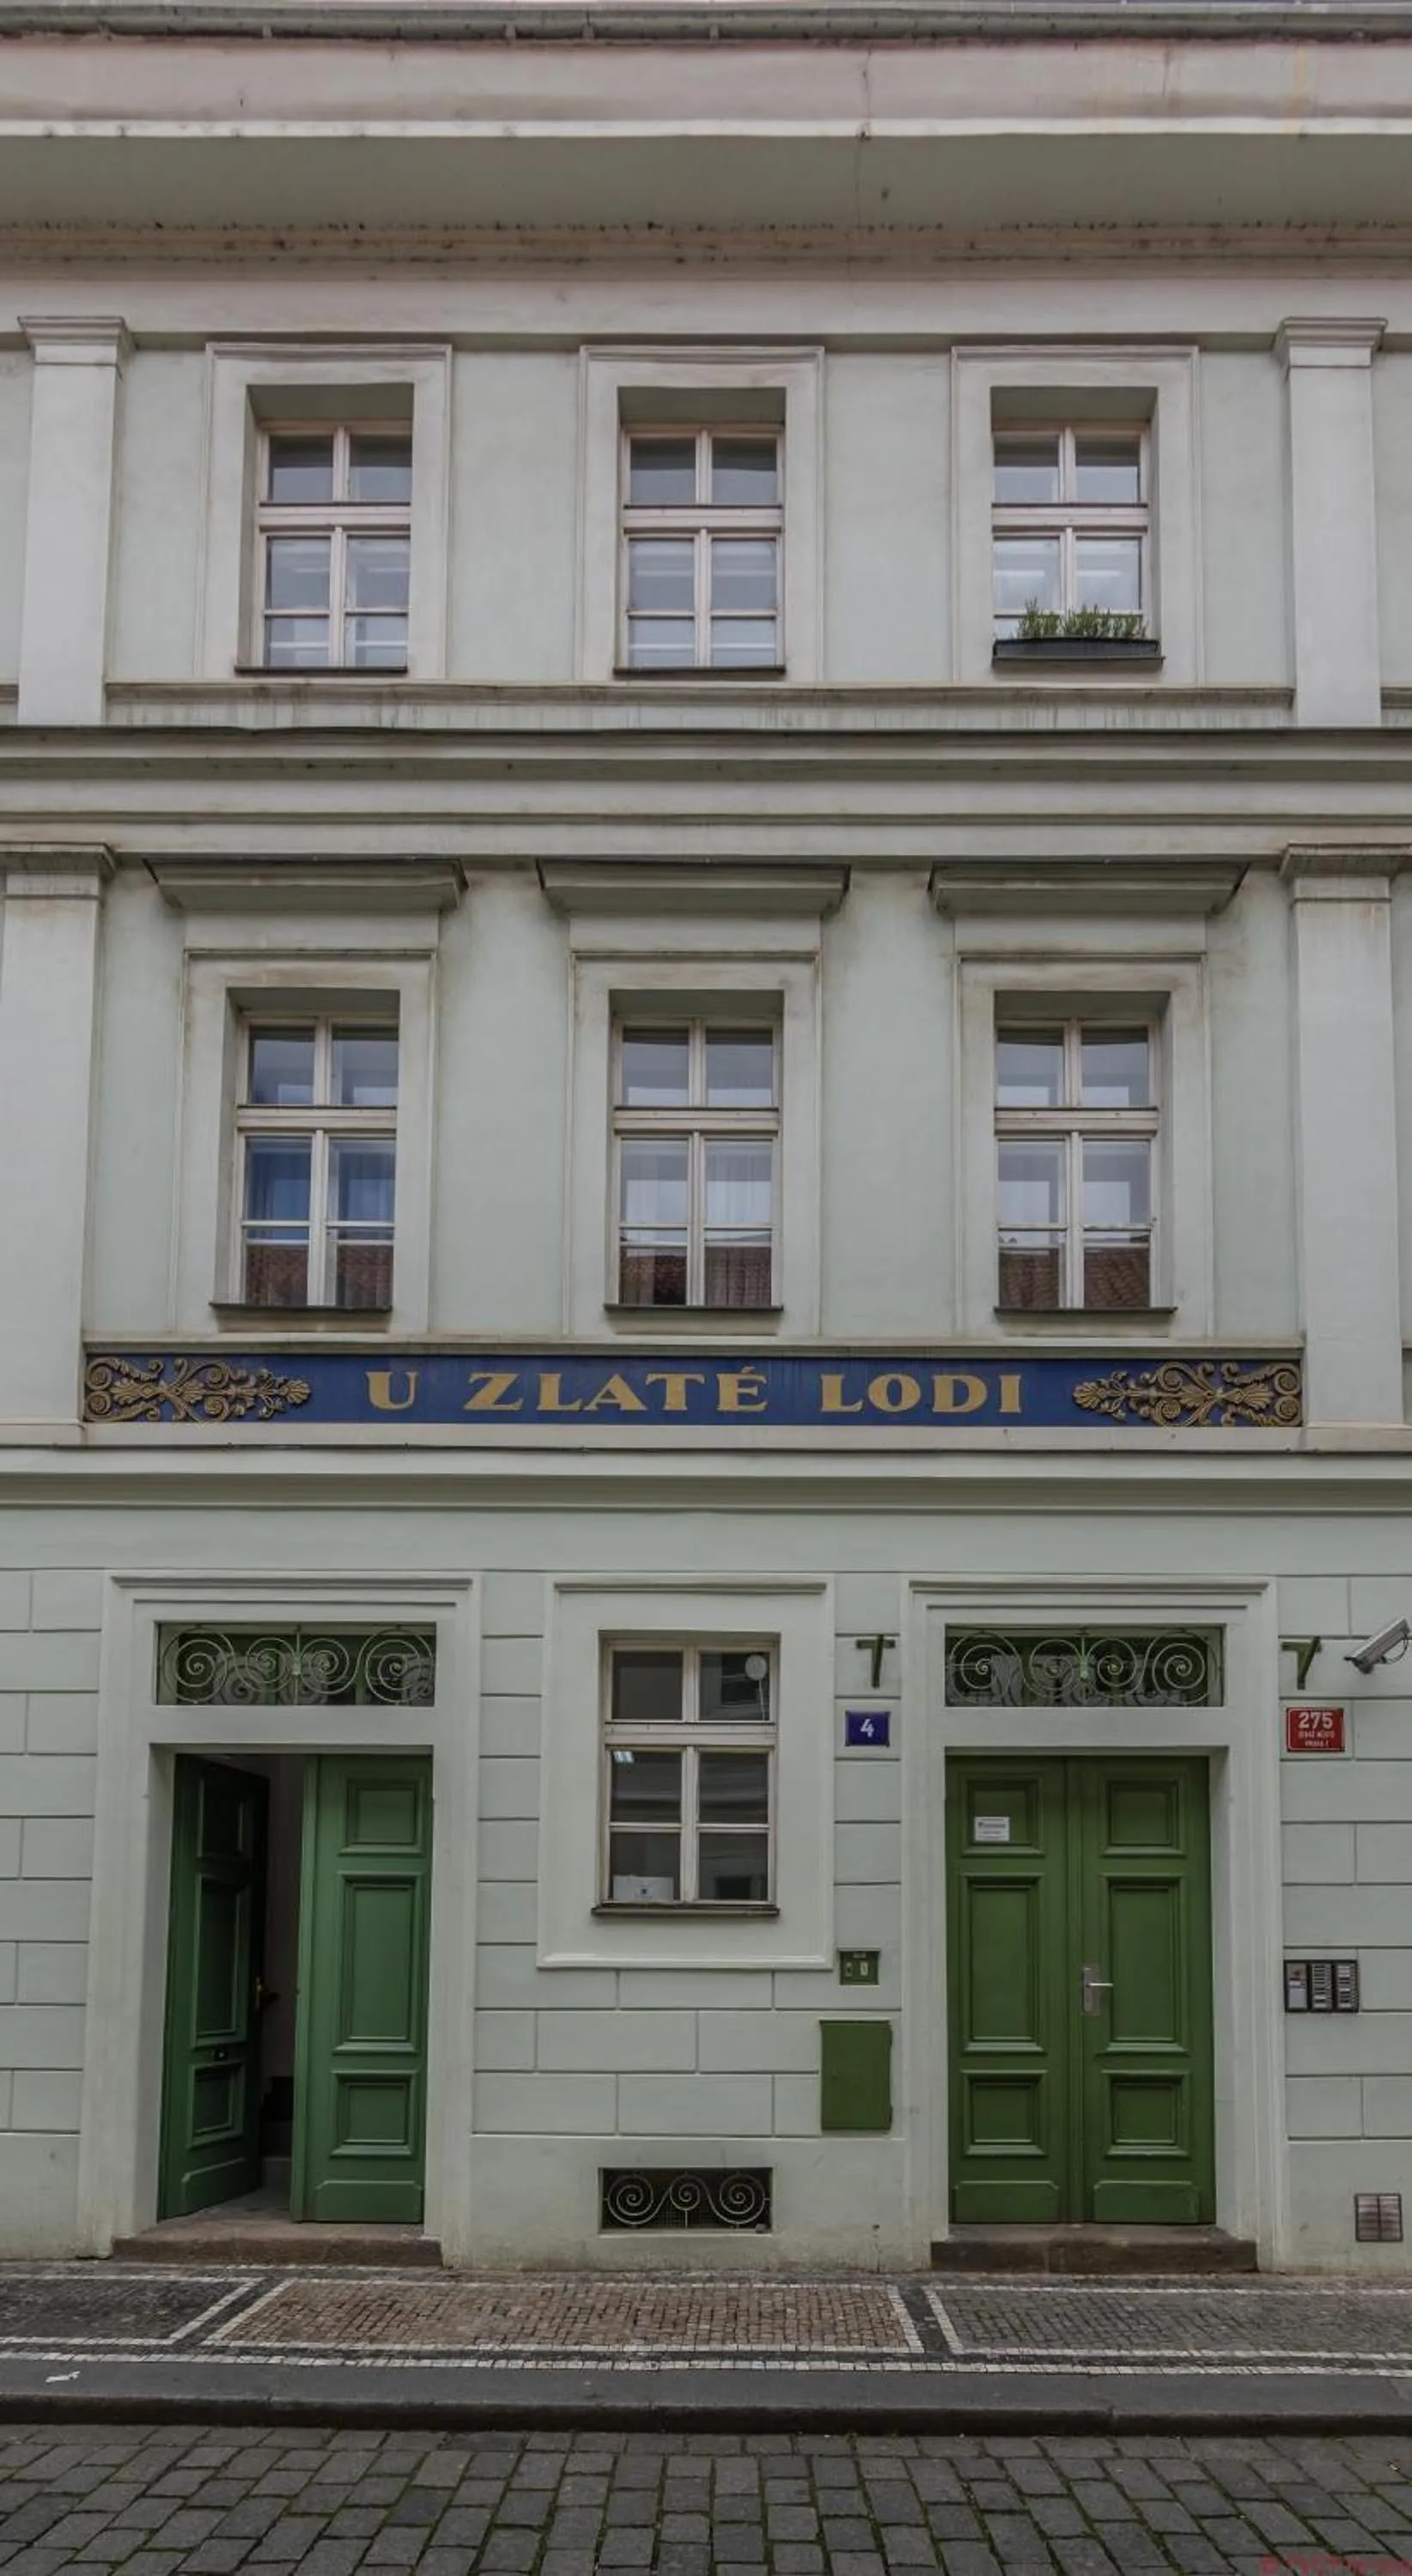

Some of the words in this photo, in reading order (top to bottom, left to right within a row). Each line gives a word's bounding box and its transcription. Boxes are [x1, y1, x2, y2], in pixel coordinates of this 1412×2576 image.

[367, 1371, 417, 1410] U
[463, 1366, 768, 1413] ZLATÉ
[820, 1373, 1022, 1413] LODI
[860, 1718, 875, 1738] 4
[1298, 1711, 1334, 1730] 275
